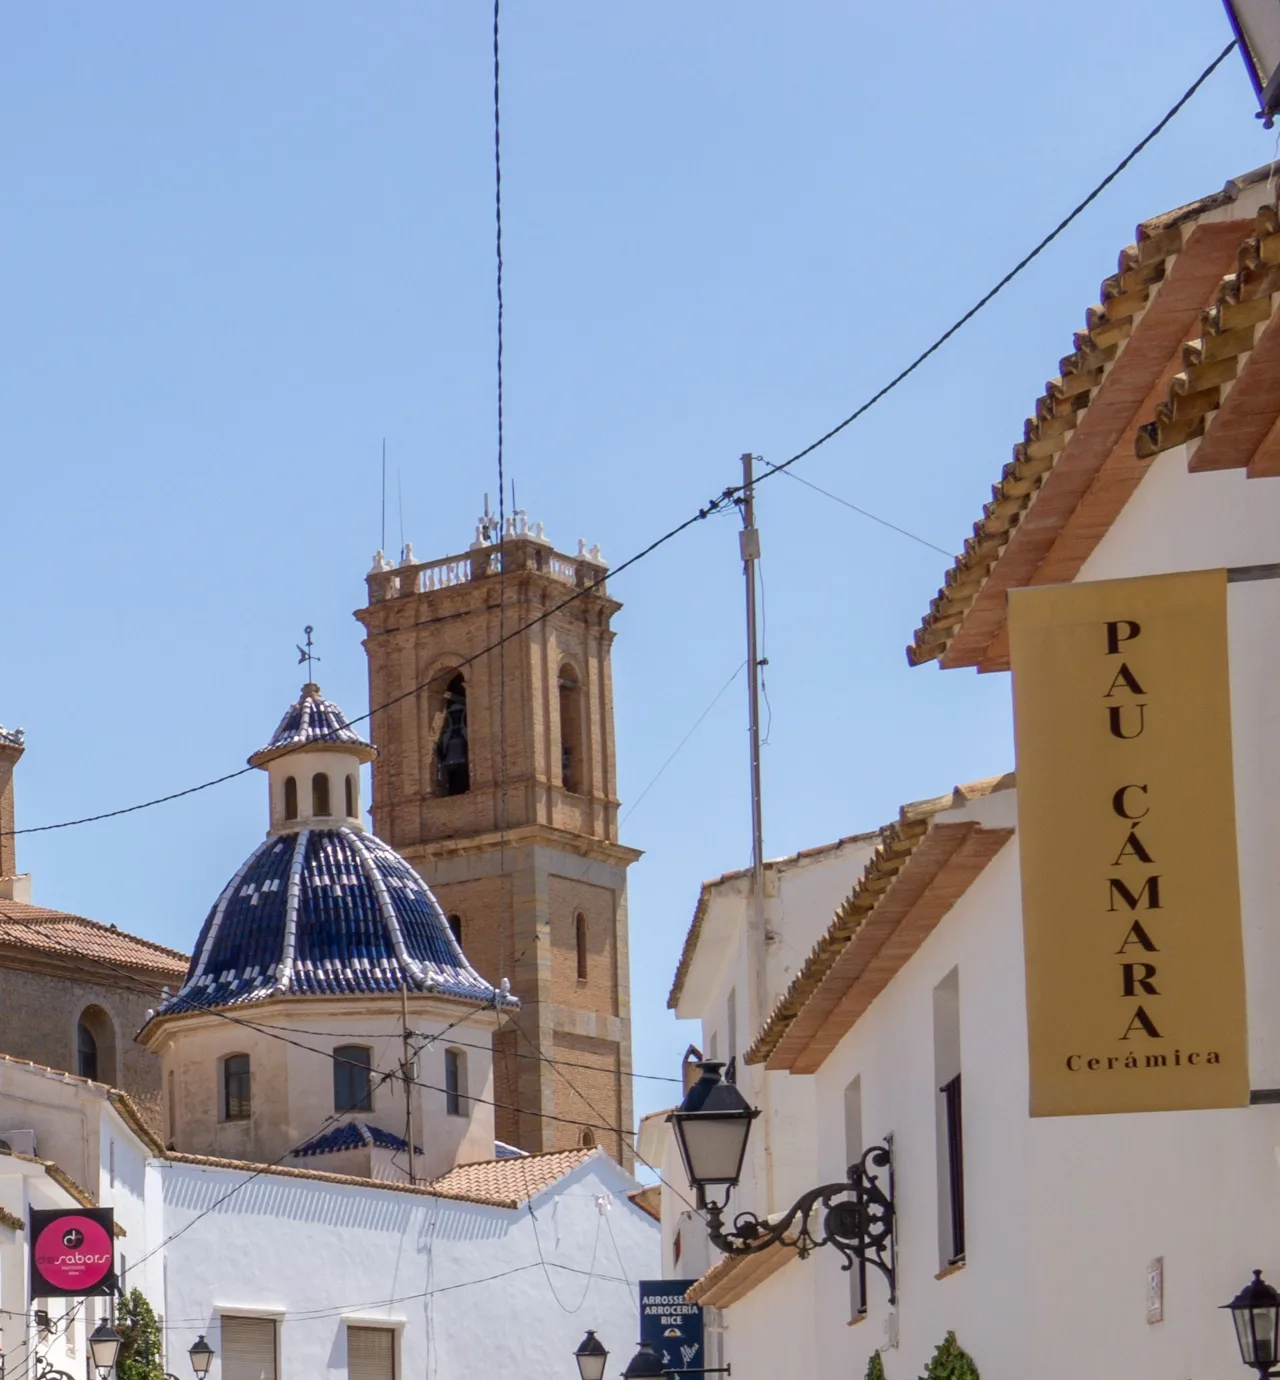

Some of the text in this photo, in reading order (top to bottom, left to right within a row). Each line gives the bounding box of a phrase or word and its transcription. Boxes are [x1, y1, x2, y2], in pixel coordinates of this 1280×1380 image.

[1103, 620, 1164, 1041] PAU CÁMARA
[1066, 1048, 1221, 1072] Cerámica
[642, 1295, 689, 1305] ARROSSE
[644, 1304, 699, 1315] ARROCERÍA
[660, 1315, 683, 1325] RICE
